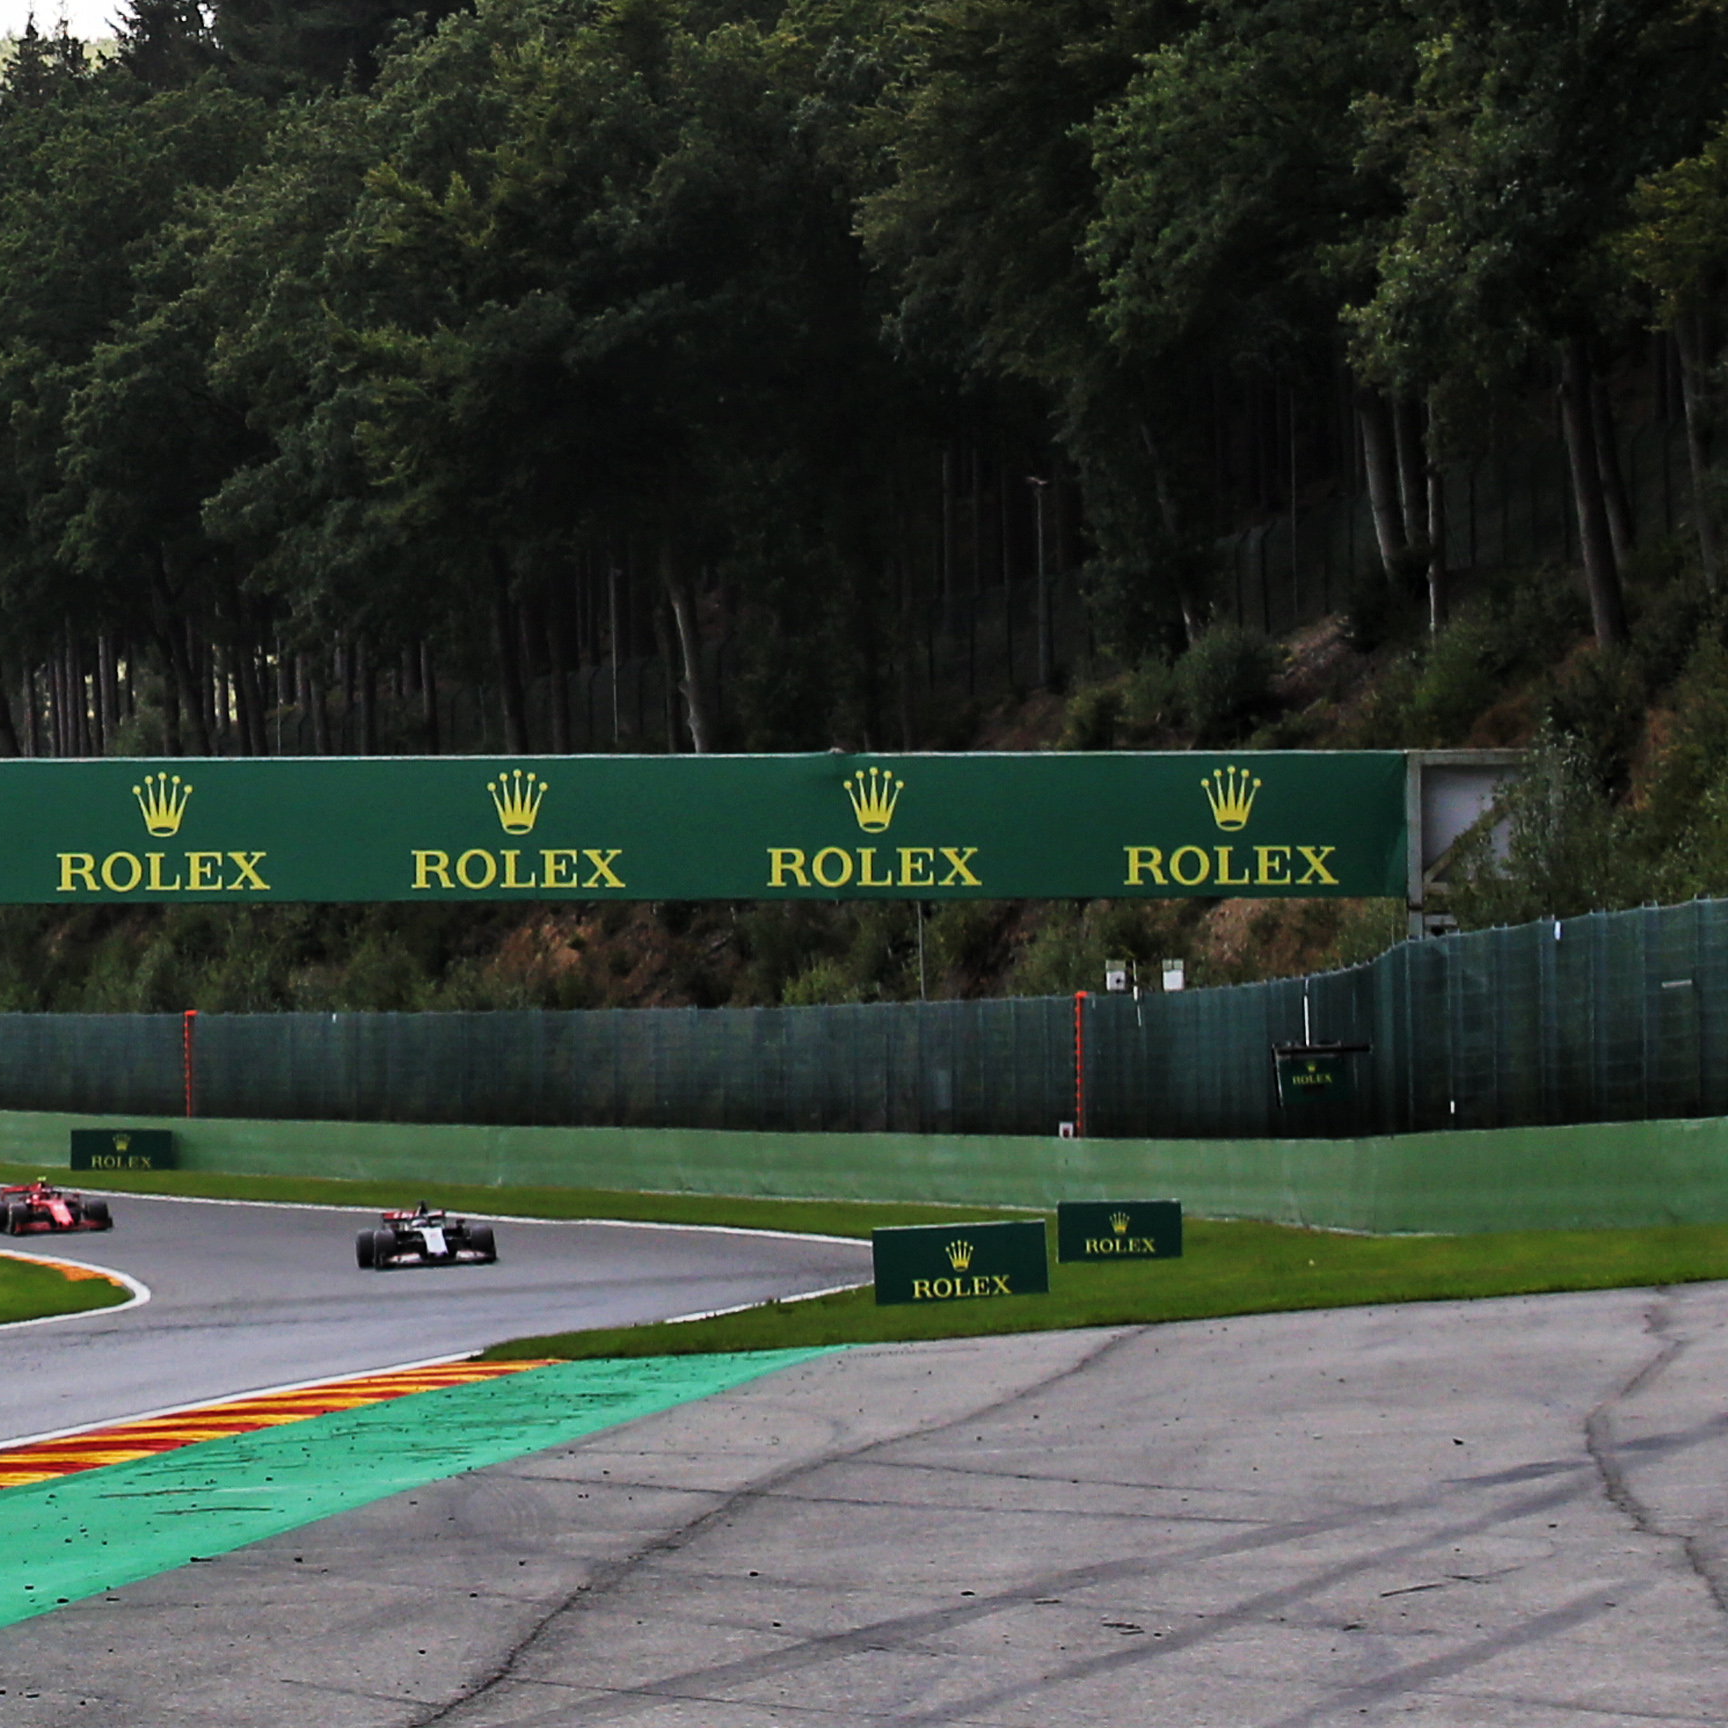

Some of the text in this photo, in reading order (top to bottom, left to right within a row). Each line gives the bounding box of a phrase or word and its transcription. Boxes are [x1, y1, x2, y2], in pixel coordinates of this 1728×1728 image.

[56, 851, 271, 893] ROLEX
[411, 848, 626, 890] ROLEX
[766, 846, 983, 888] ROLEX
[1123, 845, 1340, 886] ROLEX
[1292, 1073, 1332, 1086] ROLEX
[90, 1154, 153, 1171] ROLEX
[1085, 1238, 1155, 1255] ROLEX
[912, 1275, 1011, 1299] ROLEX
